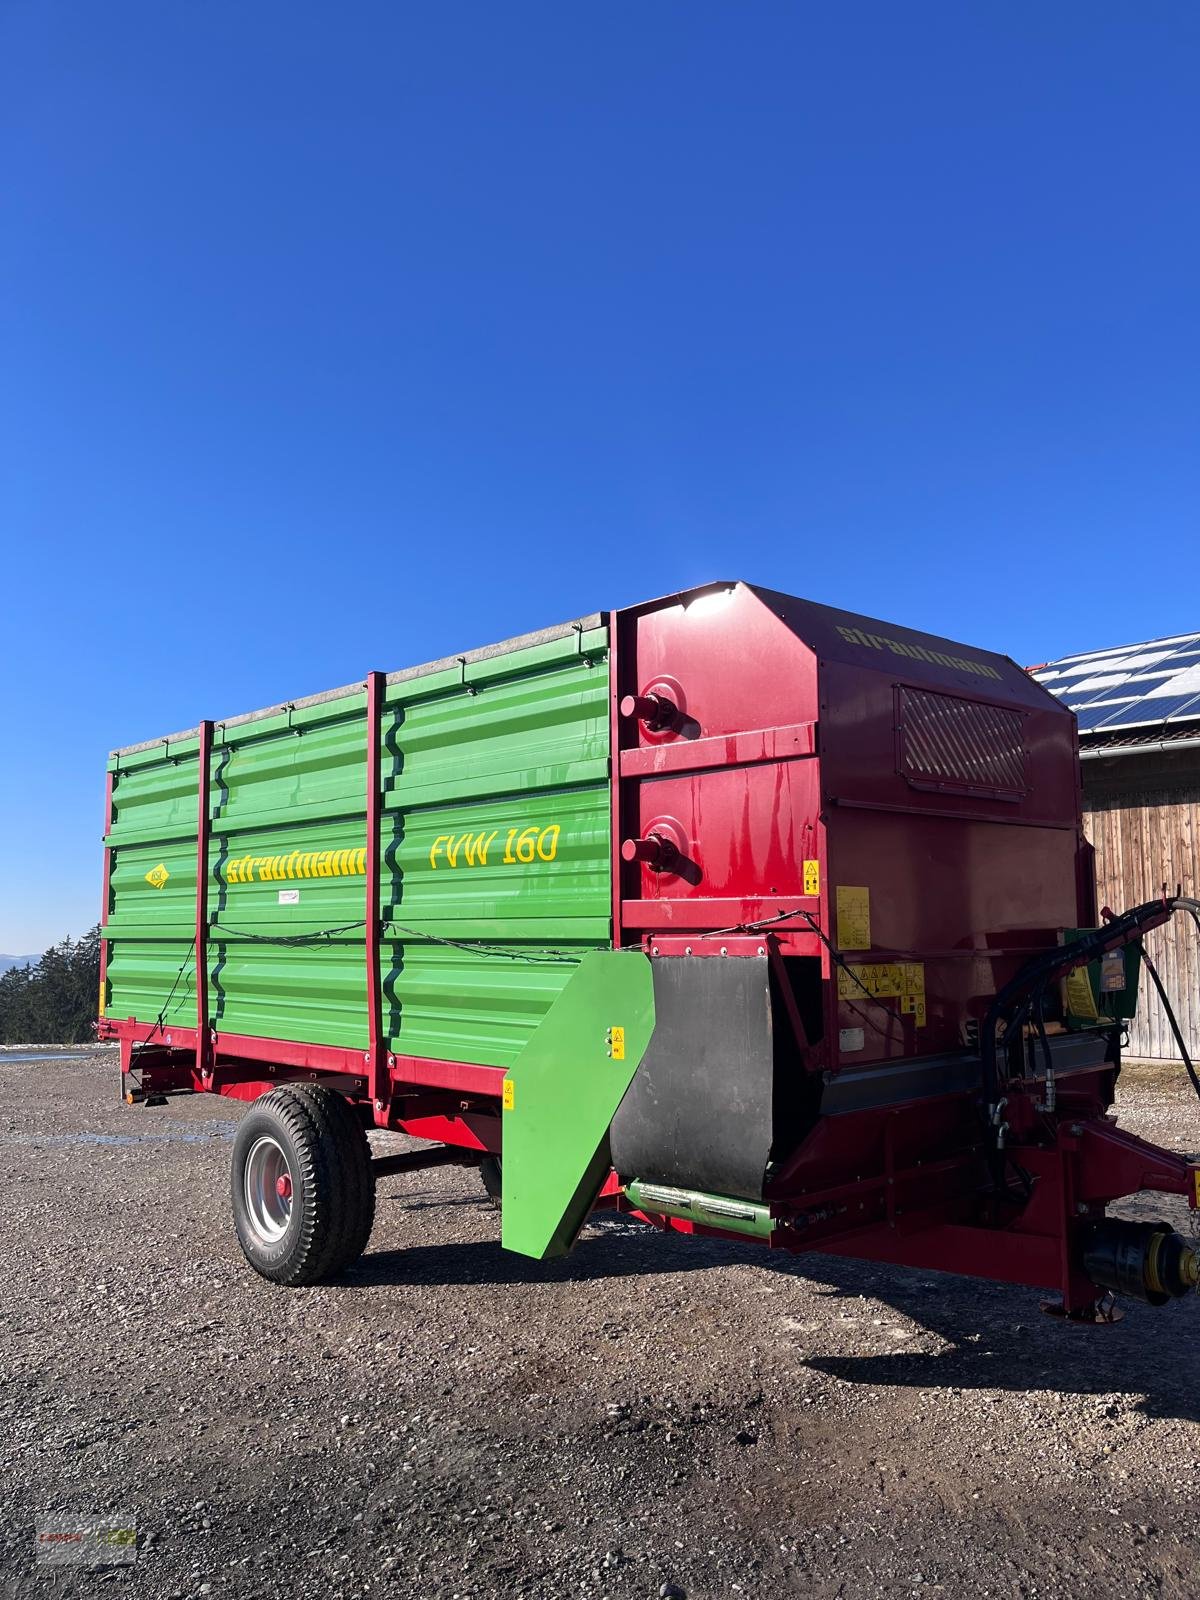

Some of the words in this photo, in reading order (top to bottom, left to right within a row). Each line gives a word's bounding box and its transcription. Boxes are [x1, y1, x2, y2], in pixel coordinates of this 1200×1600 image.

[835, 625, 1003, 680] strautmann
[226, 847, 367, 884] strautmann
[429, 830, 499, 869] FVW
[502, 824, 561, 863] 160
